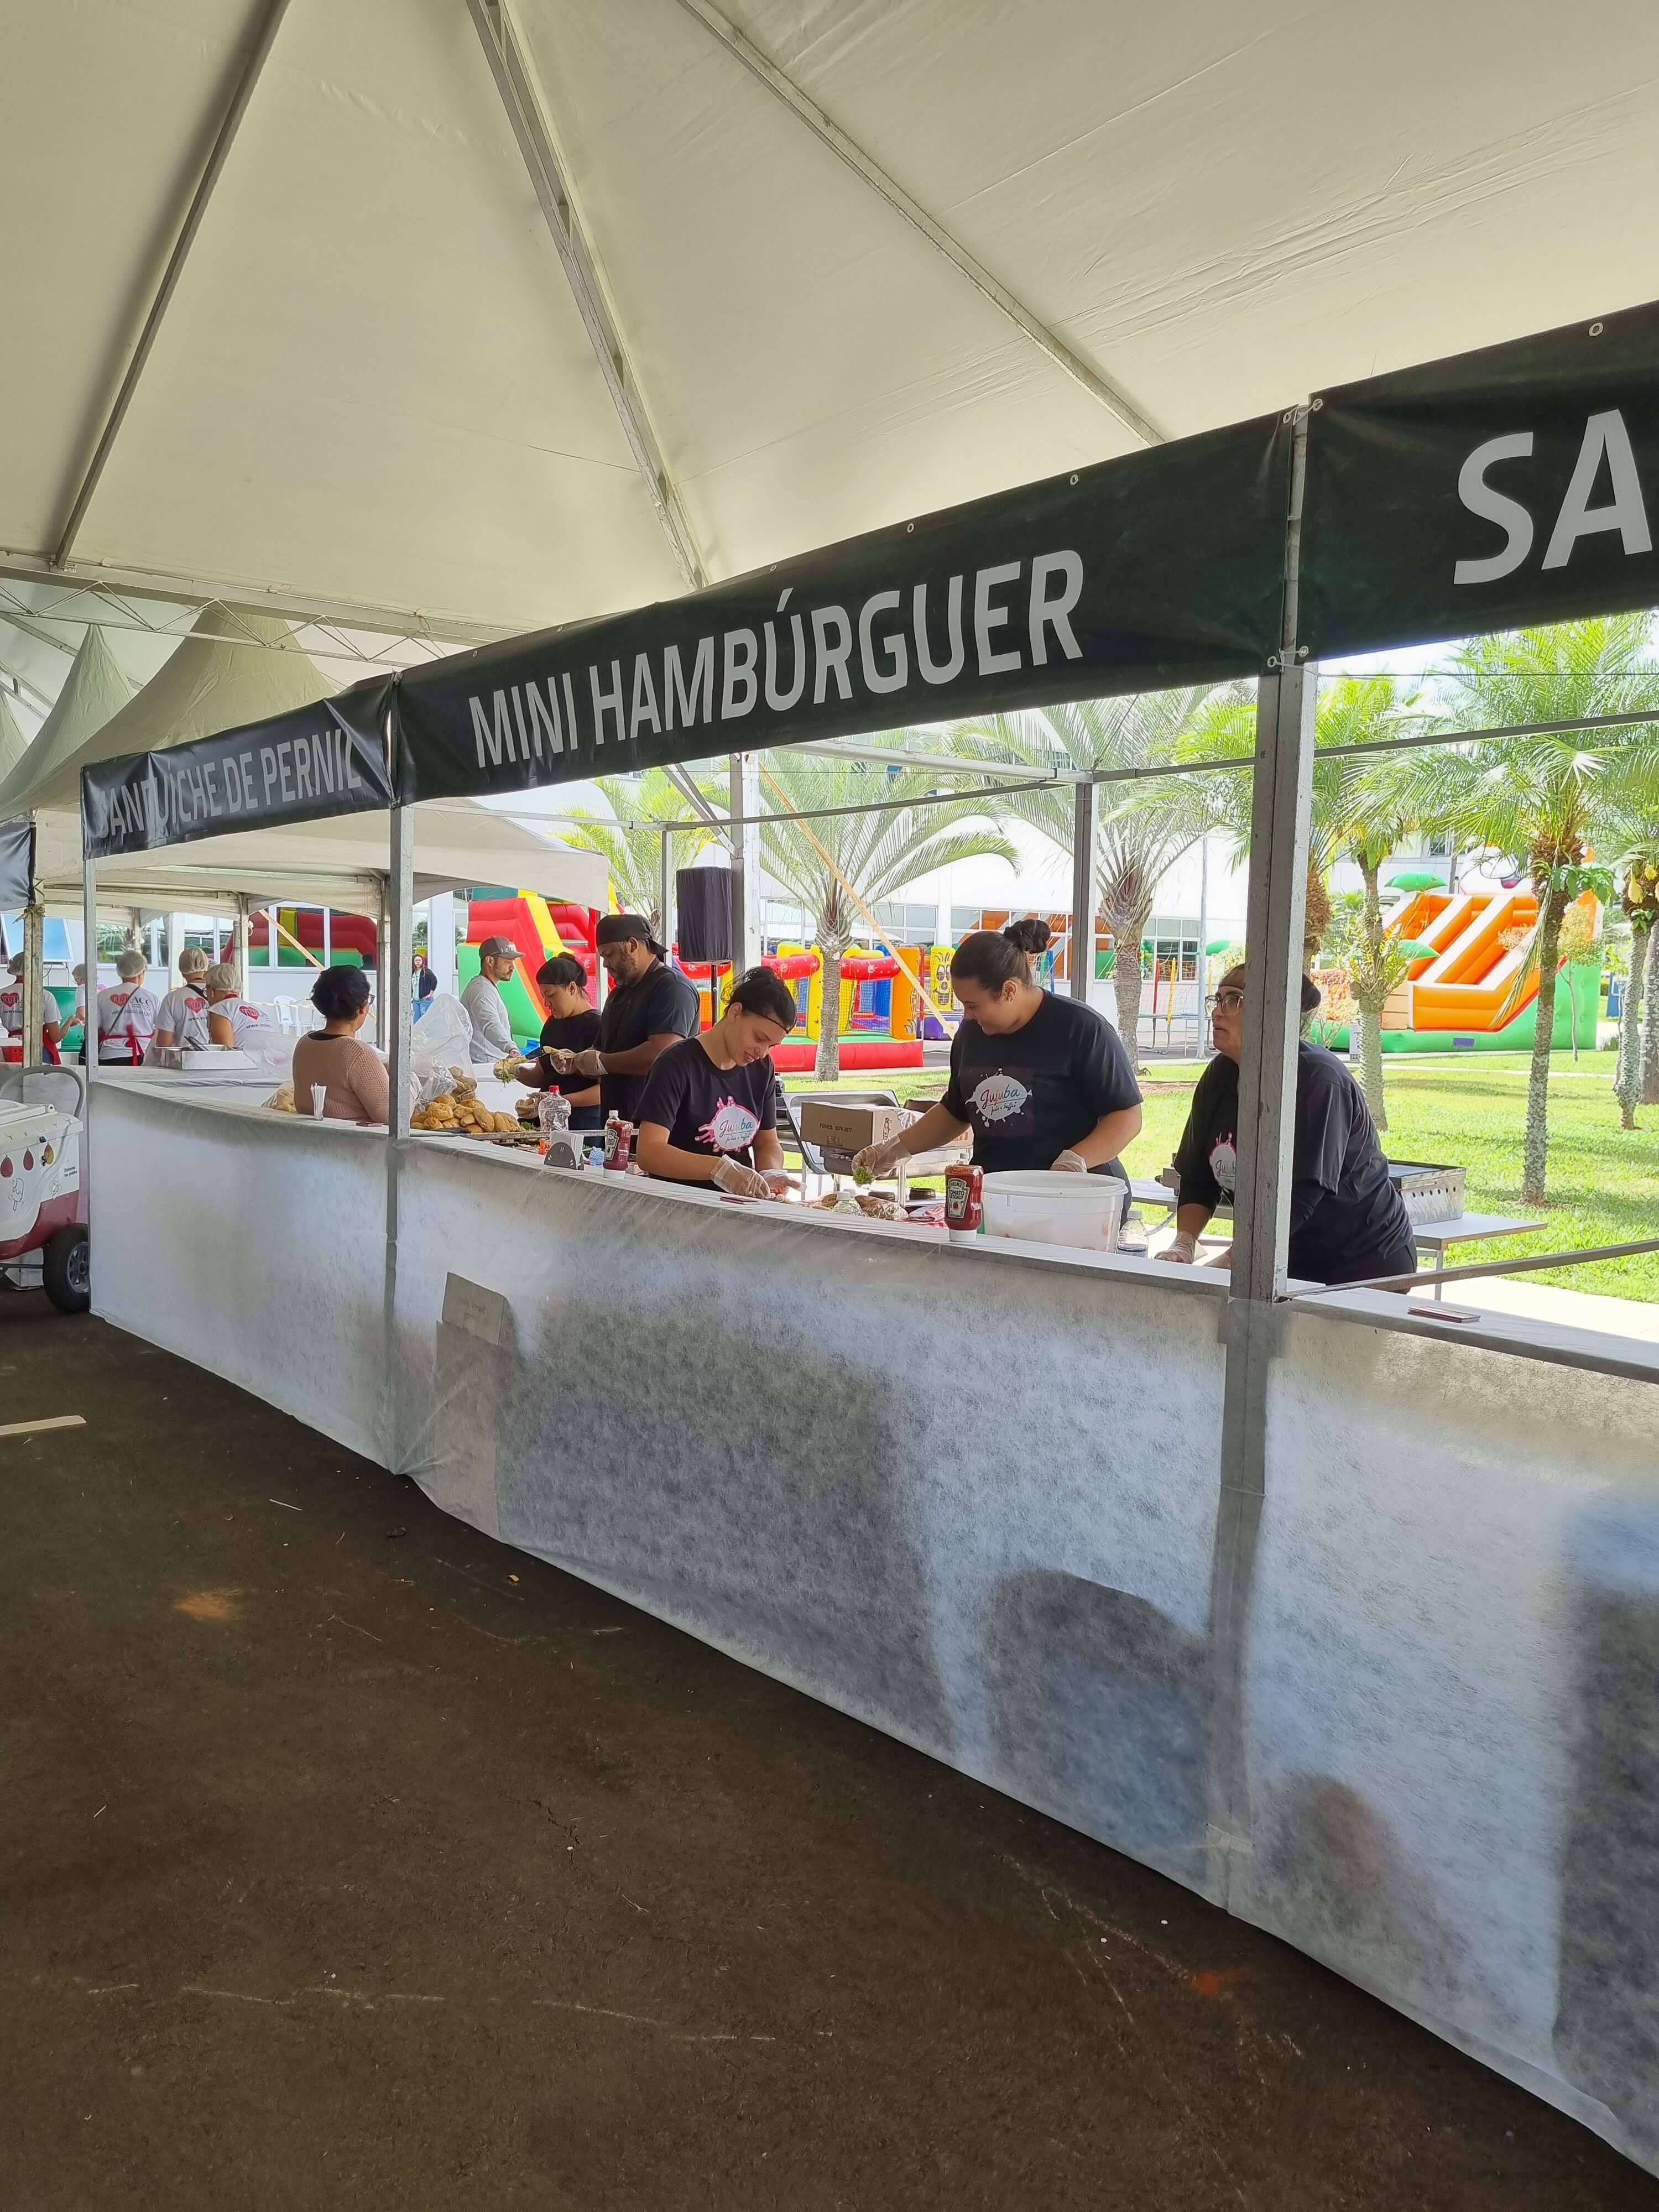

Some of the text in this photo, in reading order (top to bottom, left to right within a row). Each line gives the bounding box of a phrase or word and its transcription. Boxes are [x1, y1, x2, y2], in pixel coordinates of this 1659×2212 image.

[1454, 409, 1652, 585] SA
[469, 550, 1083, 768] MINI HAMBÚRGUER
[222, 752, 258, 813] DE
[260, 728, 362, 806] PERNIL
[980, 1083, 1020, 1110] Jujuba
